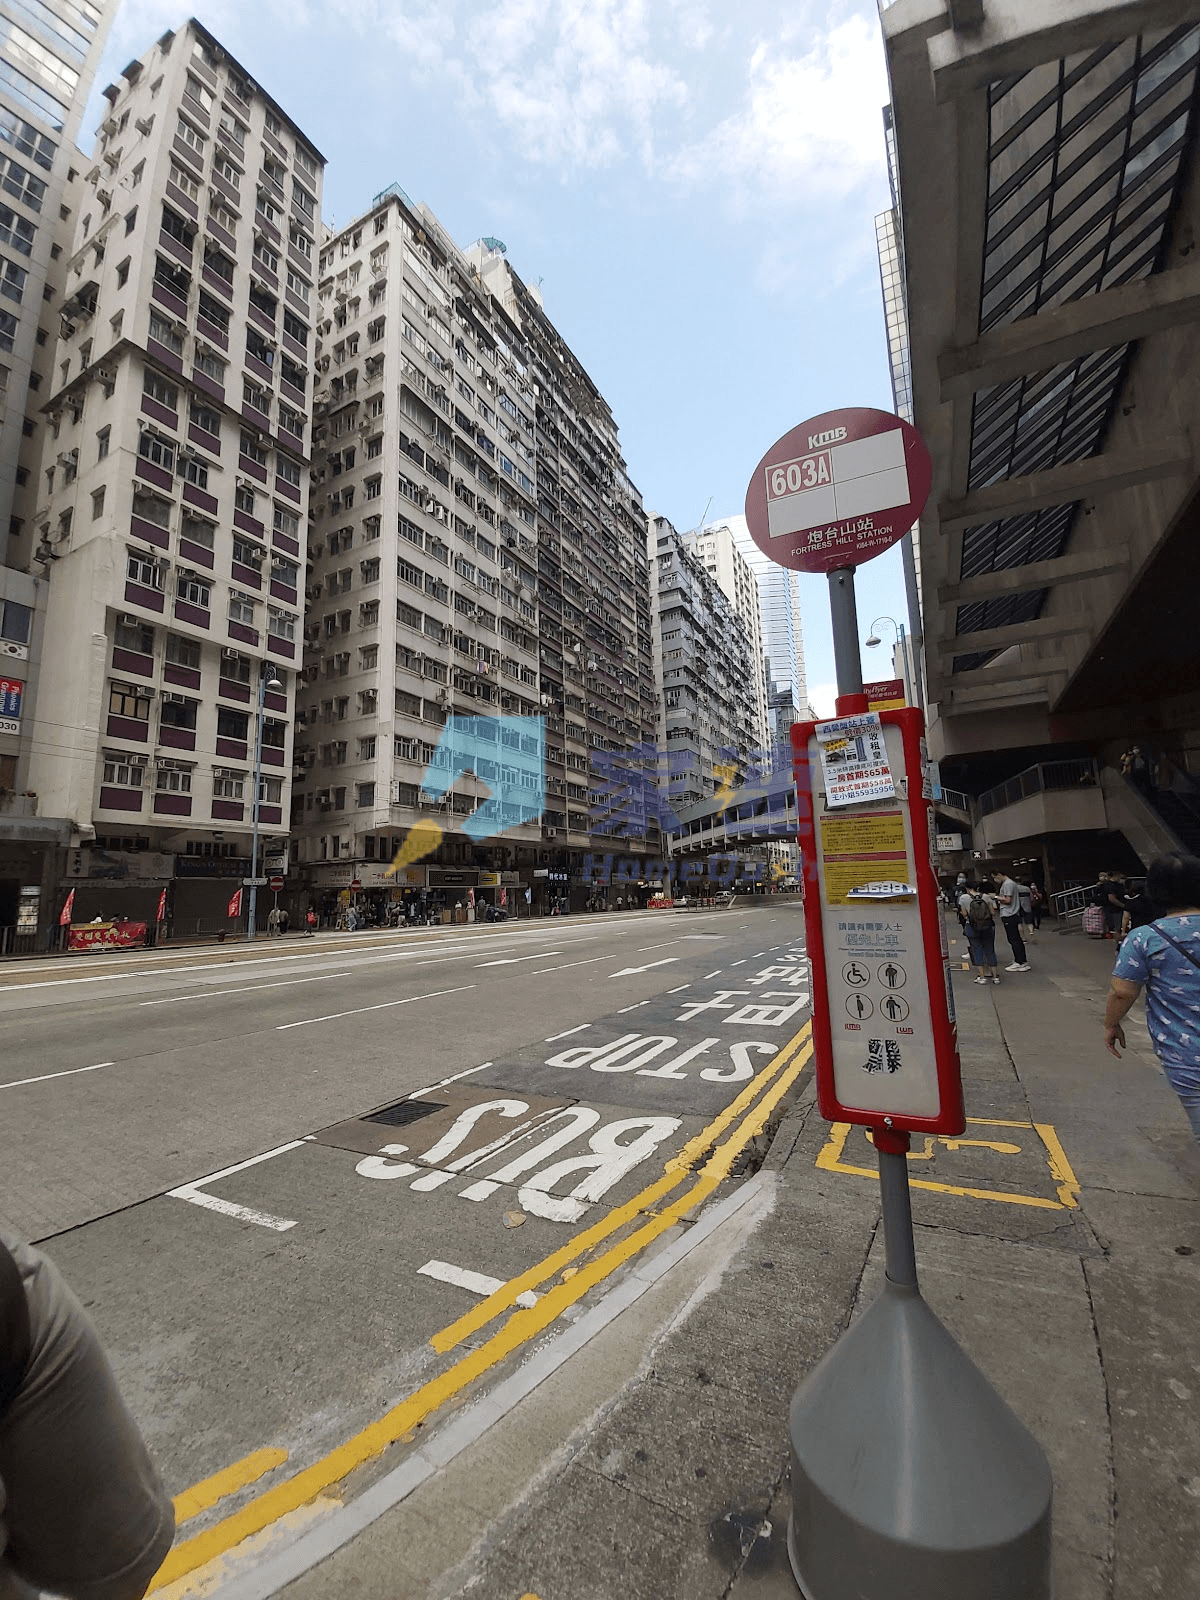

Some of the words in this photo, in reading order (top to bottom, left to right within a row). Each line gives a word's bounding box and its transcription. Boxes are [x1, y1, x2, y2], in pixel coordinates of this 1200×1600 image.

[771, 456, 830, 496] 603A
[791, 540, 833, 557] FORTRESS
[835, 535, 854, 546] HILL
[857, 525, 893, 541] STATION
[807, 517, 874, 543] 炮台山站
[845, 933, 900, 947] 優先上車
[544, 1033, 780, 1083] STOP
[354, 1098, 684, 1224] BUS
